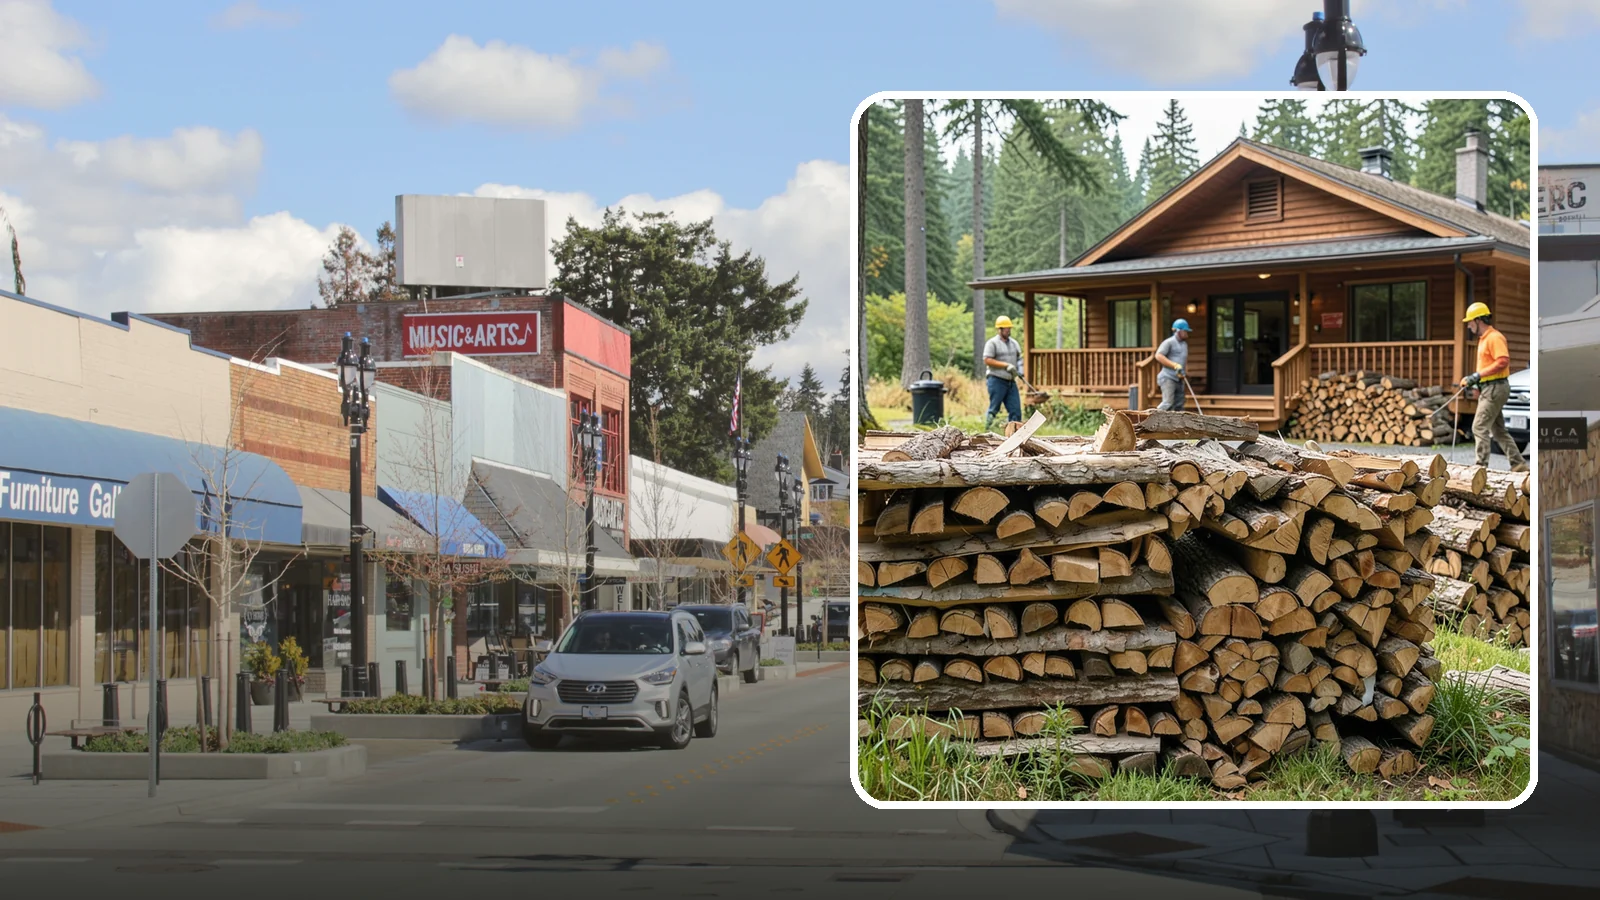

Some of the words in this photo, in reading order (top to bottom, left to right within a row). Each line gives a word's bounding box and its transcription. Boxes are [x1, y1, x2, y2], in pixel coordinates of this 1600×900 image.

[409, 323, 520, 349] MUSIC&ARTS
[1540, 427, 1578, 437] UGA
[0, 472, 79, 515] Furniture
[89, 482, 122, 519] Gal
